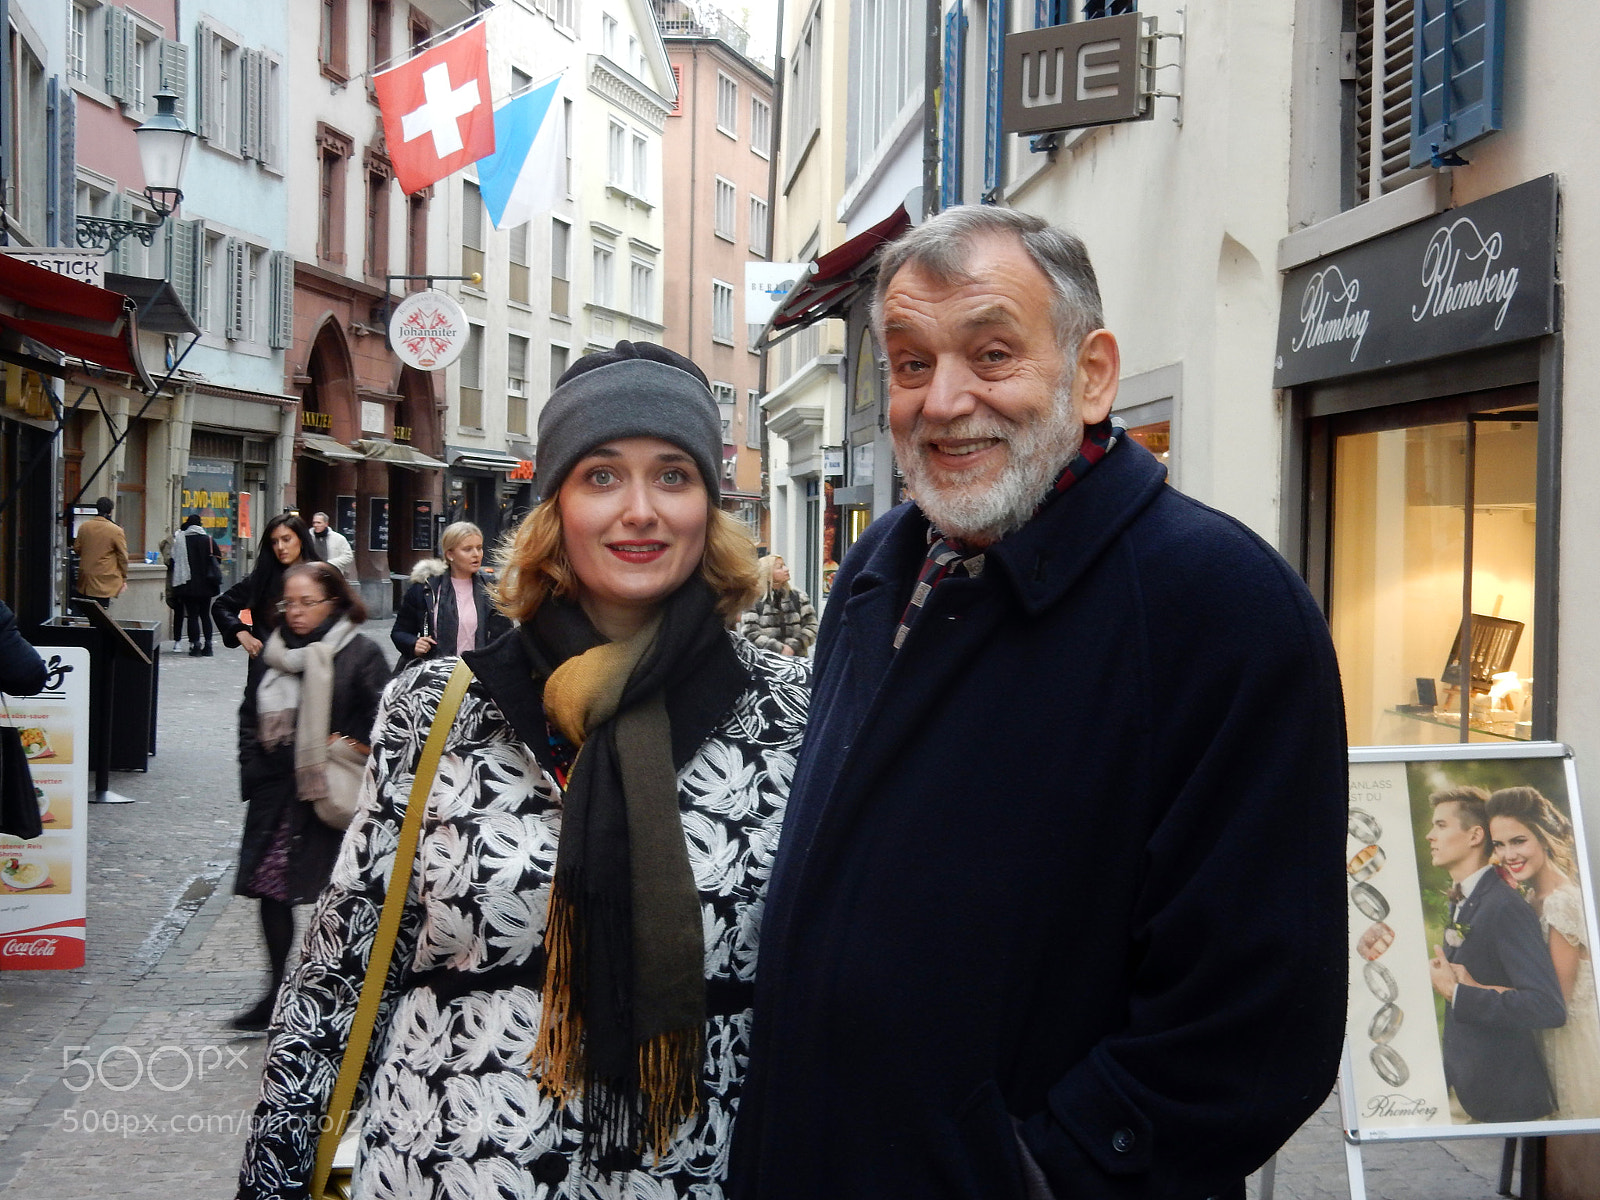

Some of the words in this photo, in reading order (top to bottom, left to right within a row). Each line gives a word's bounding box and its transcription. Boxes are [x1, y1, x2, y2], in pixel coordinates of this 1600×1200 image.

[1021, 38, 1120, 109] WE
[1411, 217, 1519, 331] Rhomberg
[398, 326, 457, 339] Johanniter
[1292, 265, 1370, 363] Rhomberg
[1361, 1093, 1438, 1121] Rhomberg
